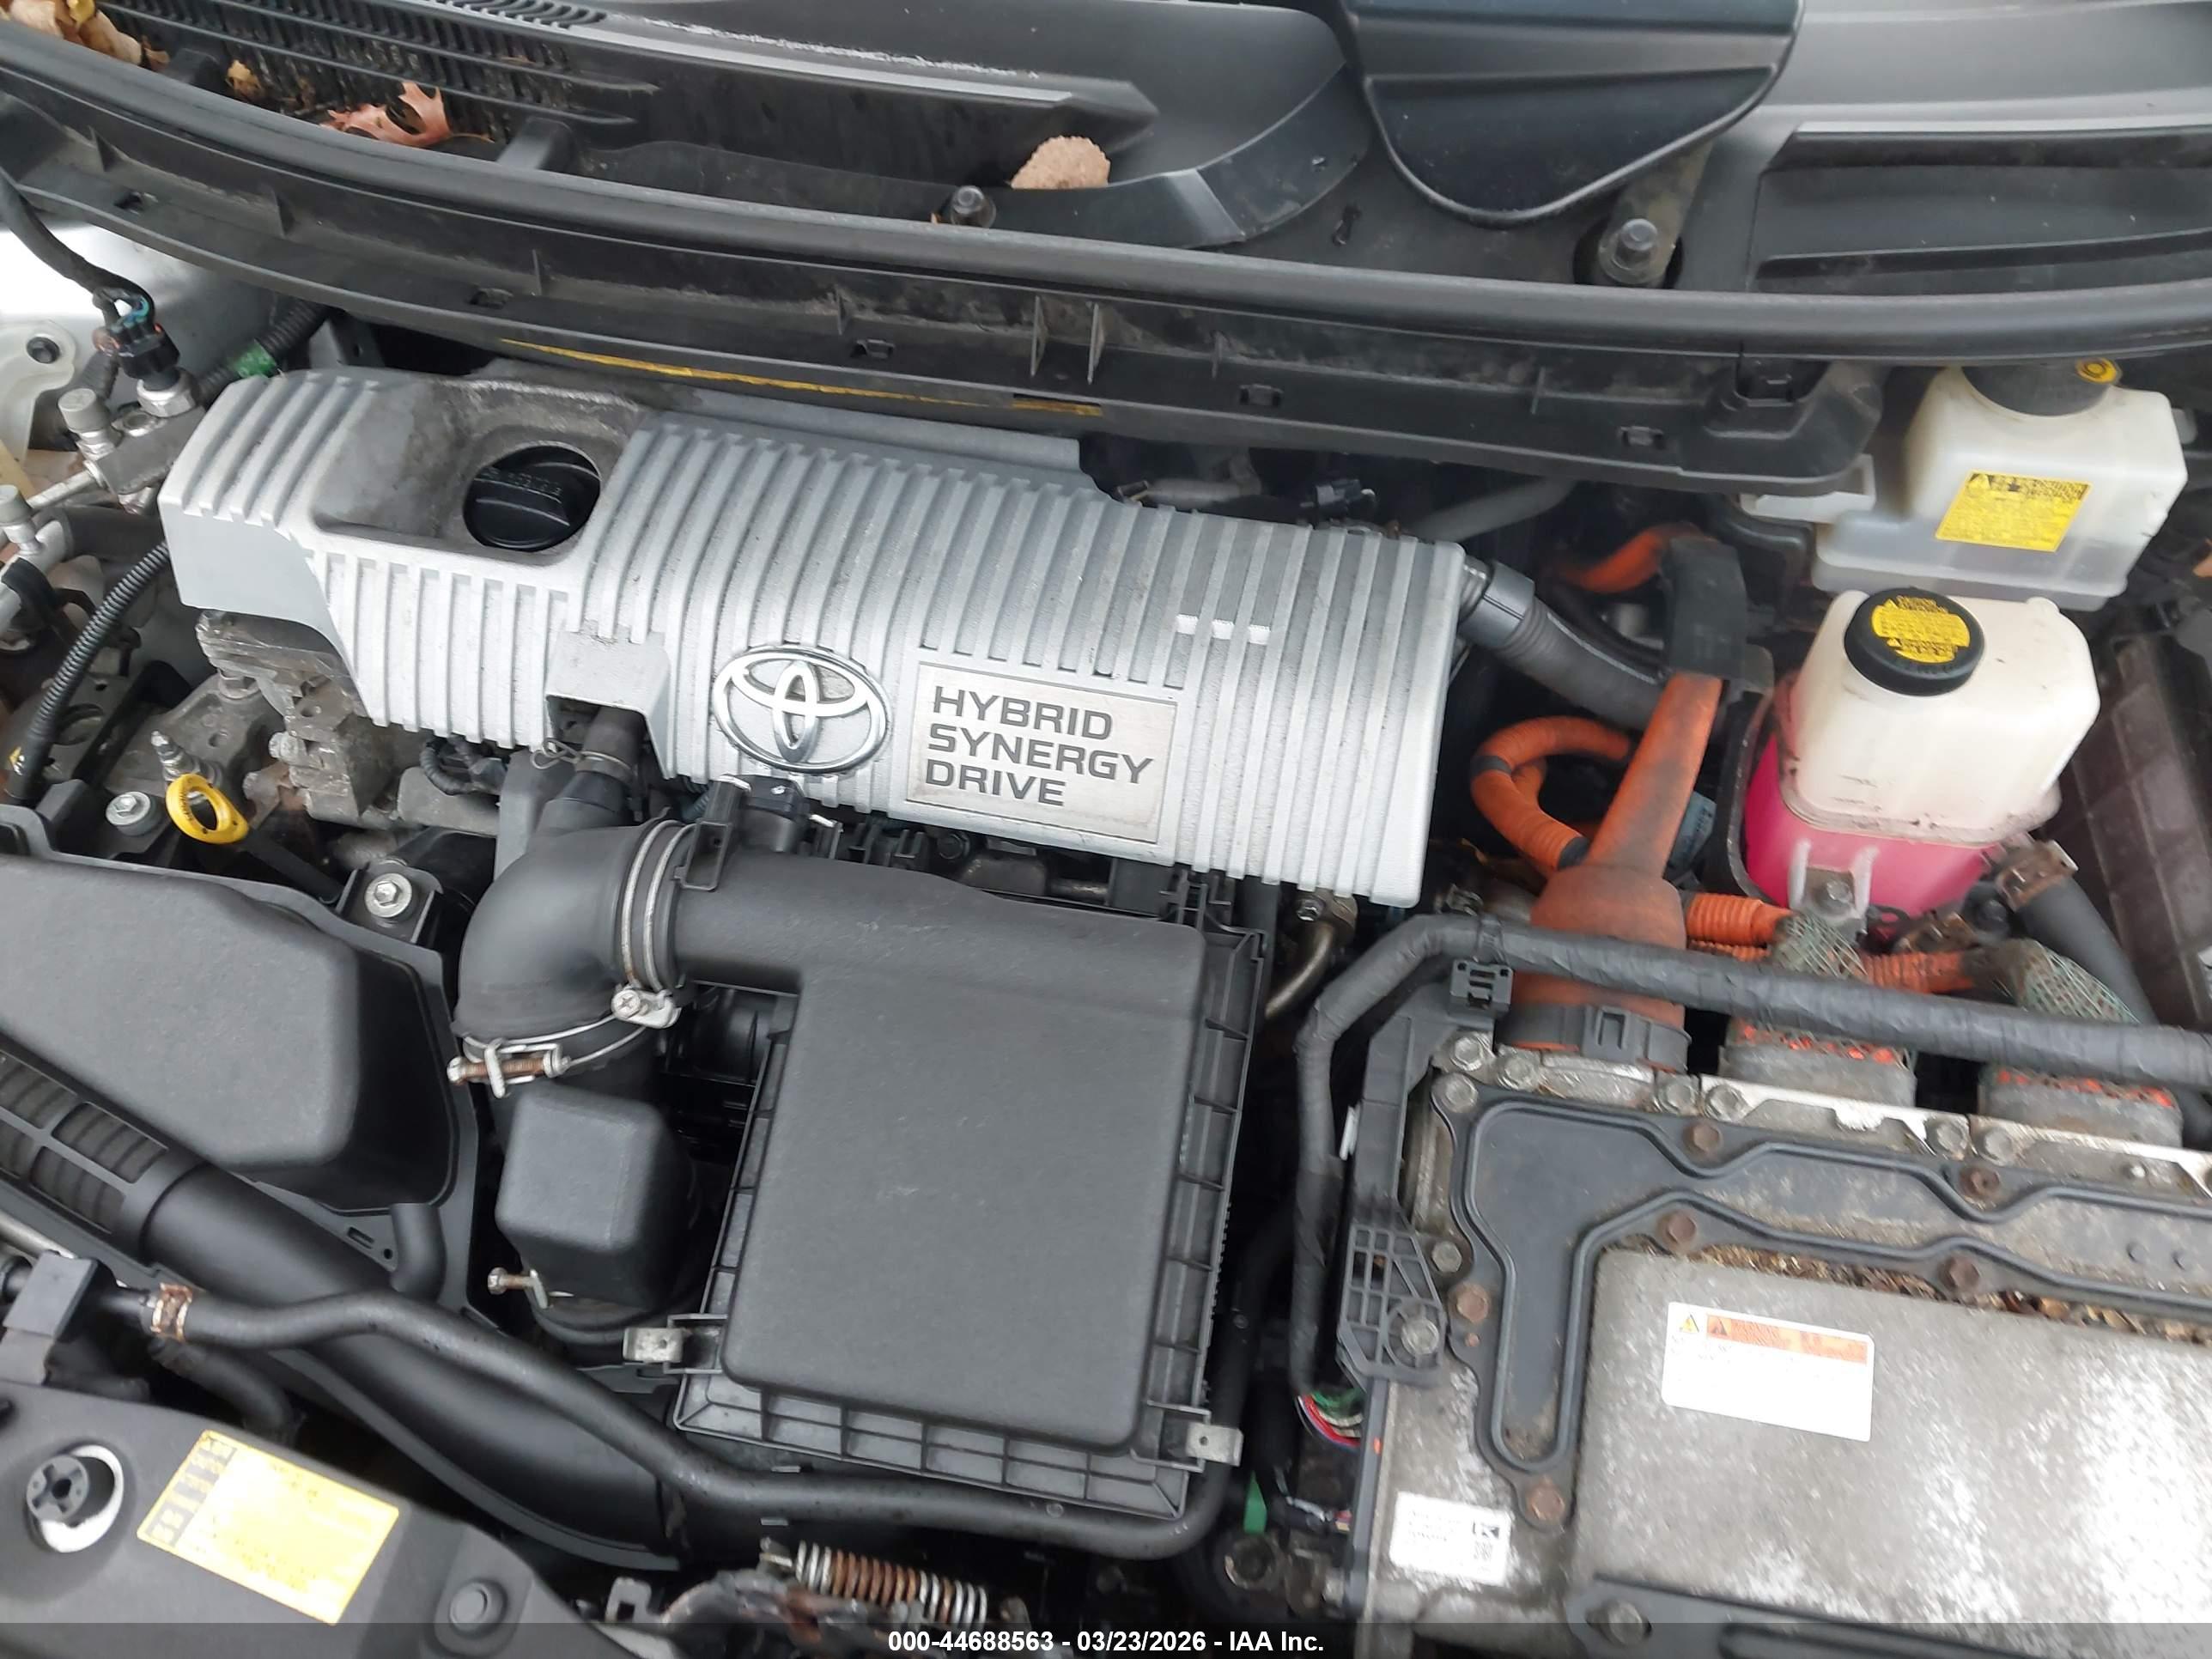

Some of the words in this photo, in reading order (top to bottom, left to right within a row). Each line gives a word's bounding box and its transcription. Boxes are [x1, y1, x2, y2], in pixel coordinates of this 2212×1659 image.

[933, 685, 1113, 740] HYBRID
[928, 723, 1153, 784] SYNERGY
[926, 758, 1066, 806] DRIVE
